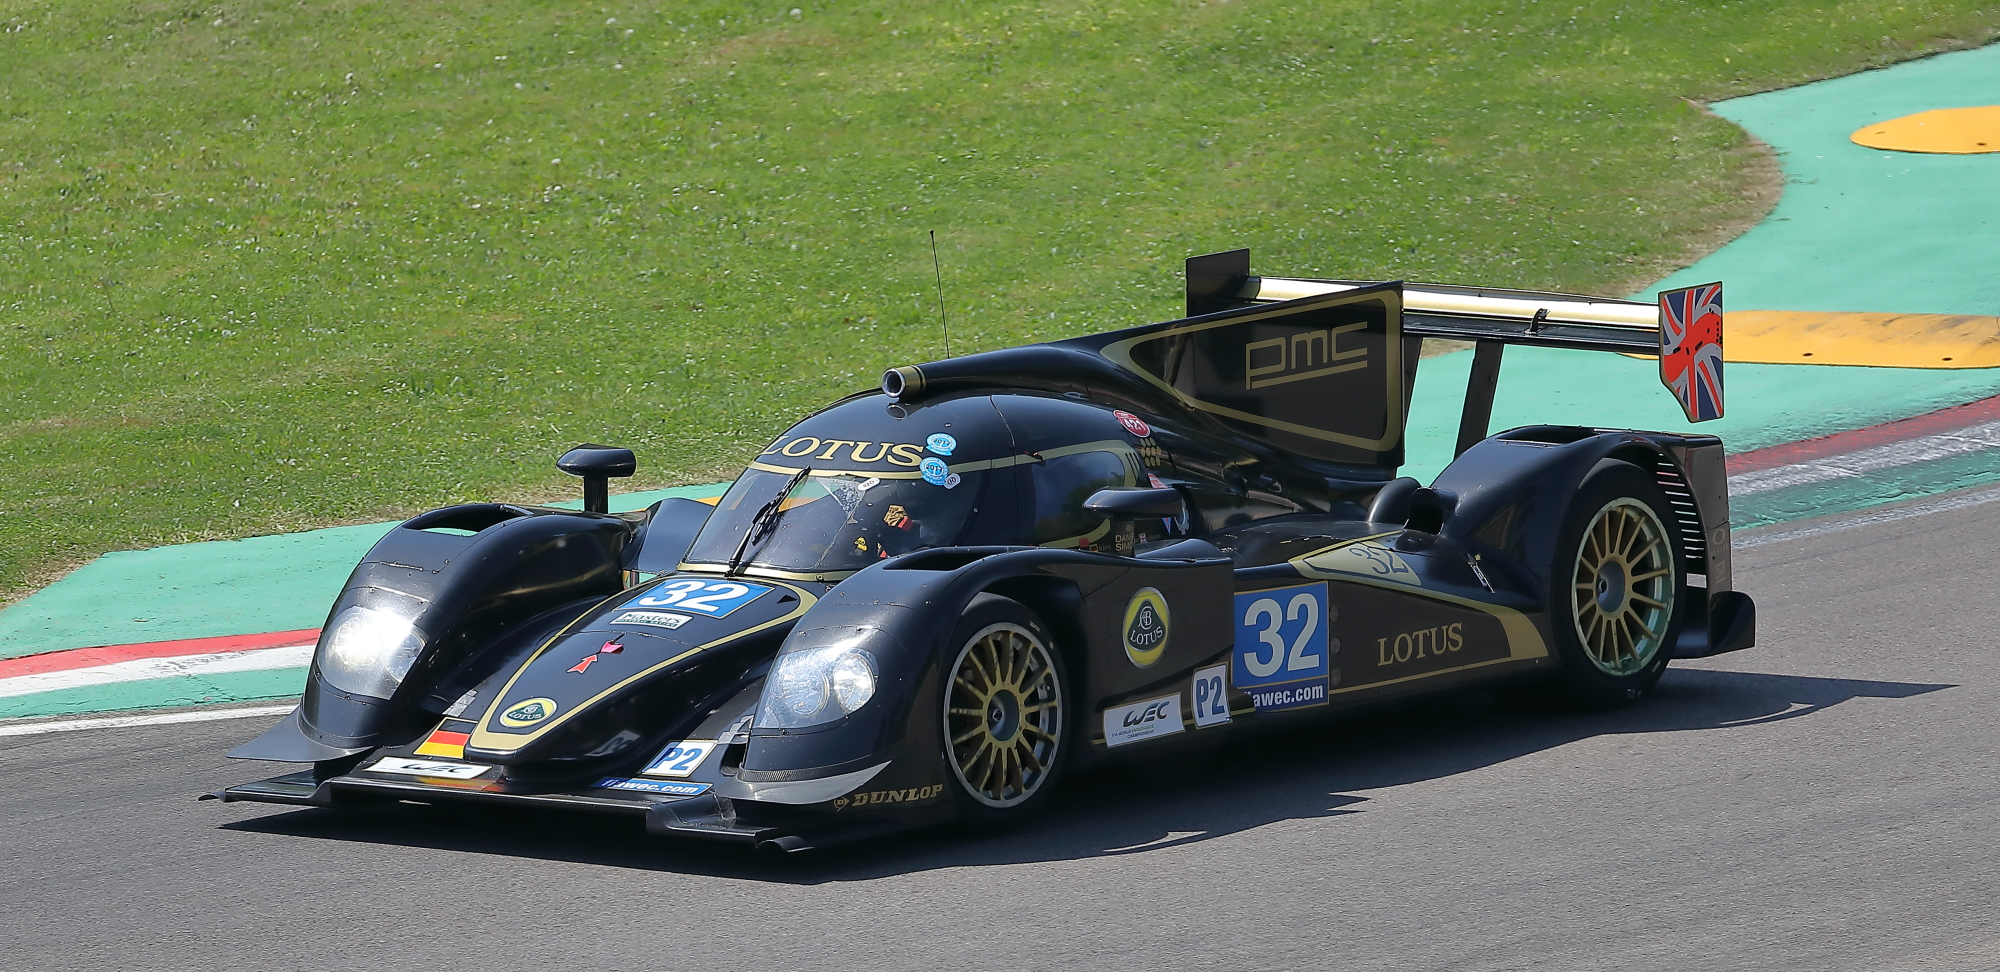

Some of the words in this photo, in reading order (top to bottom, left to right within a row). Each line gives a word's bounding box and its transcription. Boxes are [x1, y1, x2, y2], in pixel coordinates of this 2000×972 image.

[763, 435, 923, 467] LOTUS
[926, 464, 943, 472] 2017
[1348, 547, 1409, 574] 32
[638, 580, 749, 613] 32
[1129, 625, 1163, 645] LOTUS
[1243, 592, 1320, 677] 32
[1377, 622, 1463, 666] LOTUS
[1196, 676, 1225, 718] P2
[1243, 684, 1324, 707] awec.com
[508, 711, 542, 720] LOTUS
[1122, 701, 1170, 727] WEC
[1131, 724, 1155, 733] ENDURANCE
[649, 747, 703, 770] P2
[852, 784, 943, 806] DUNLOP
